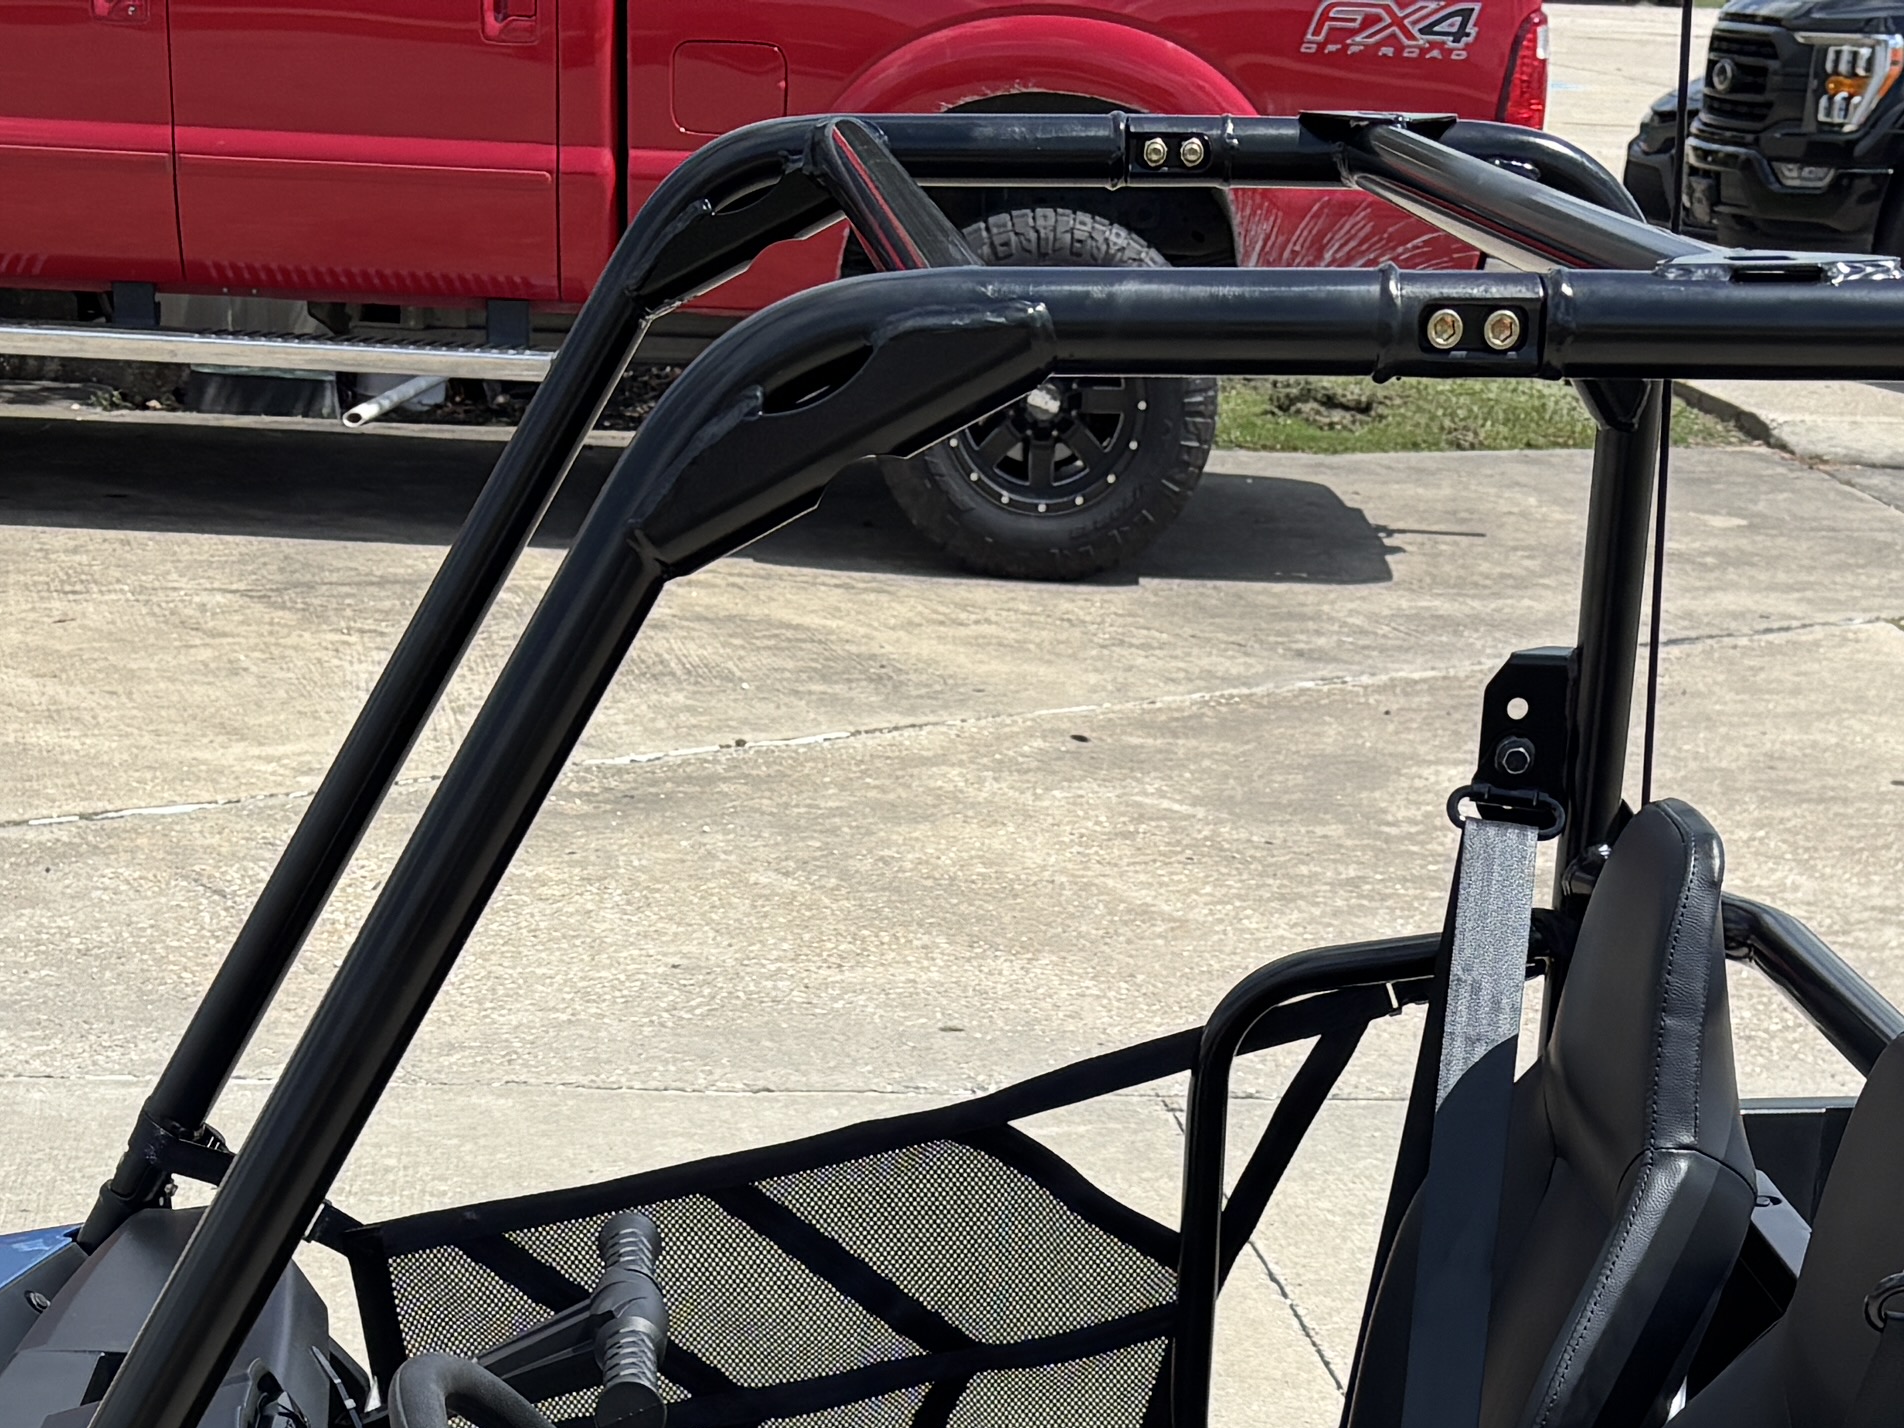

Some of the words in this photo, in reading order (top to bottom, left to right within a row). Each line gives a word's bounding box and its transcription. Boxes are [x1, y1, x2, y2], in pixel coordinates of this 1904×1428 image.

[1305, 0, 1482, 48] FX4
[1300, 43, 1364, 54] OFF
[1378, 47, 1468, 60] ROAD
